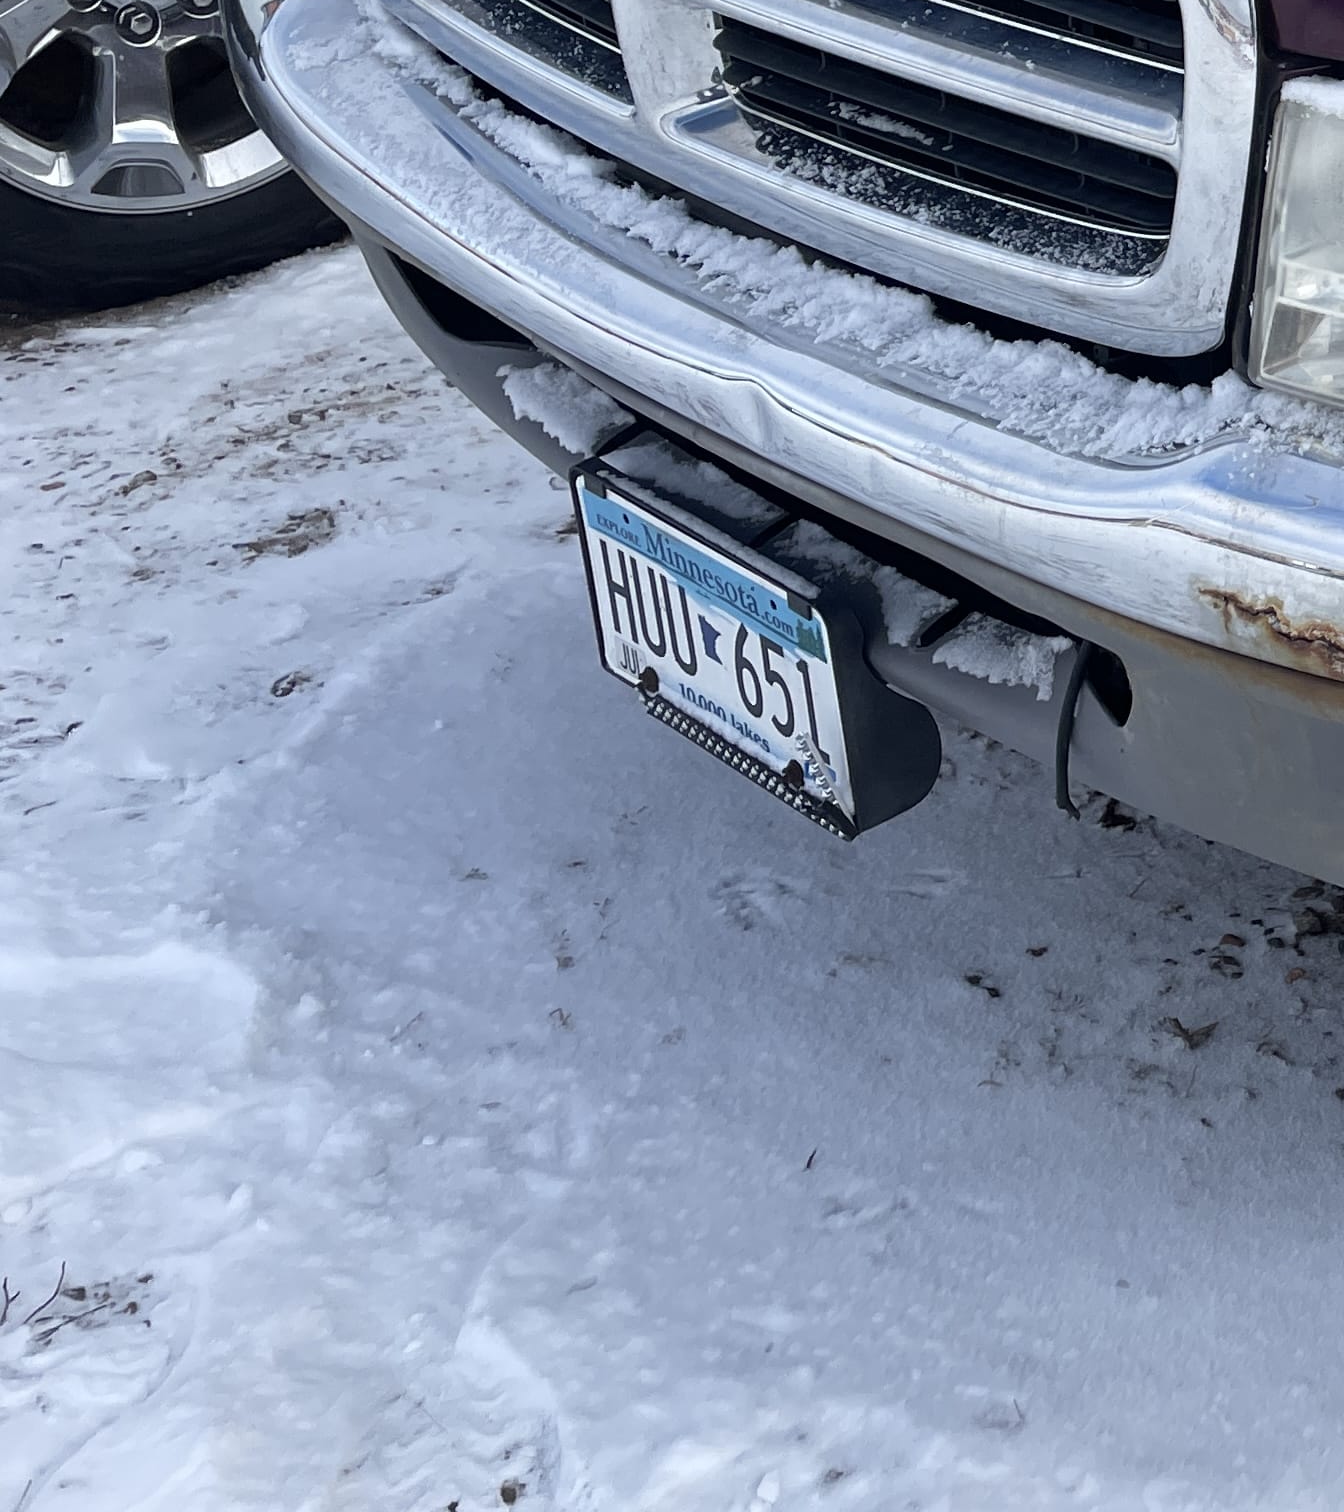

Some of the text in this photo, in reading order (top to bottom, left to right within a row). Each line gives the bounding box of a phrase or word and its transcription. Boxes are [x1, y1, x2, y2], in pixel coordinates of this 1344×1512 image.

[596, 514, 794, 637] EXPLORE Minnesota.com
[599, 539, 830, 765] HUU 651
[731, 714, 771, 753] lakes
